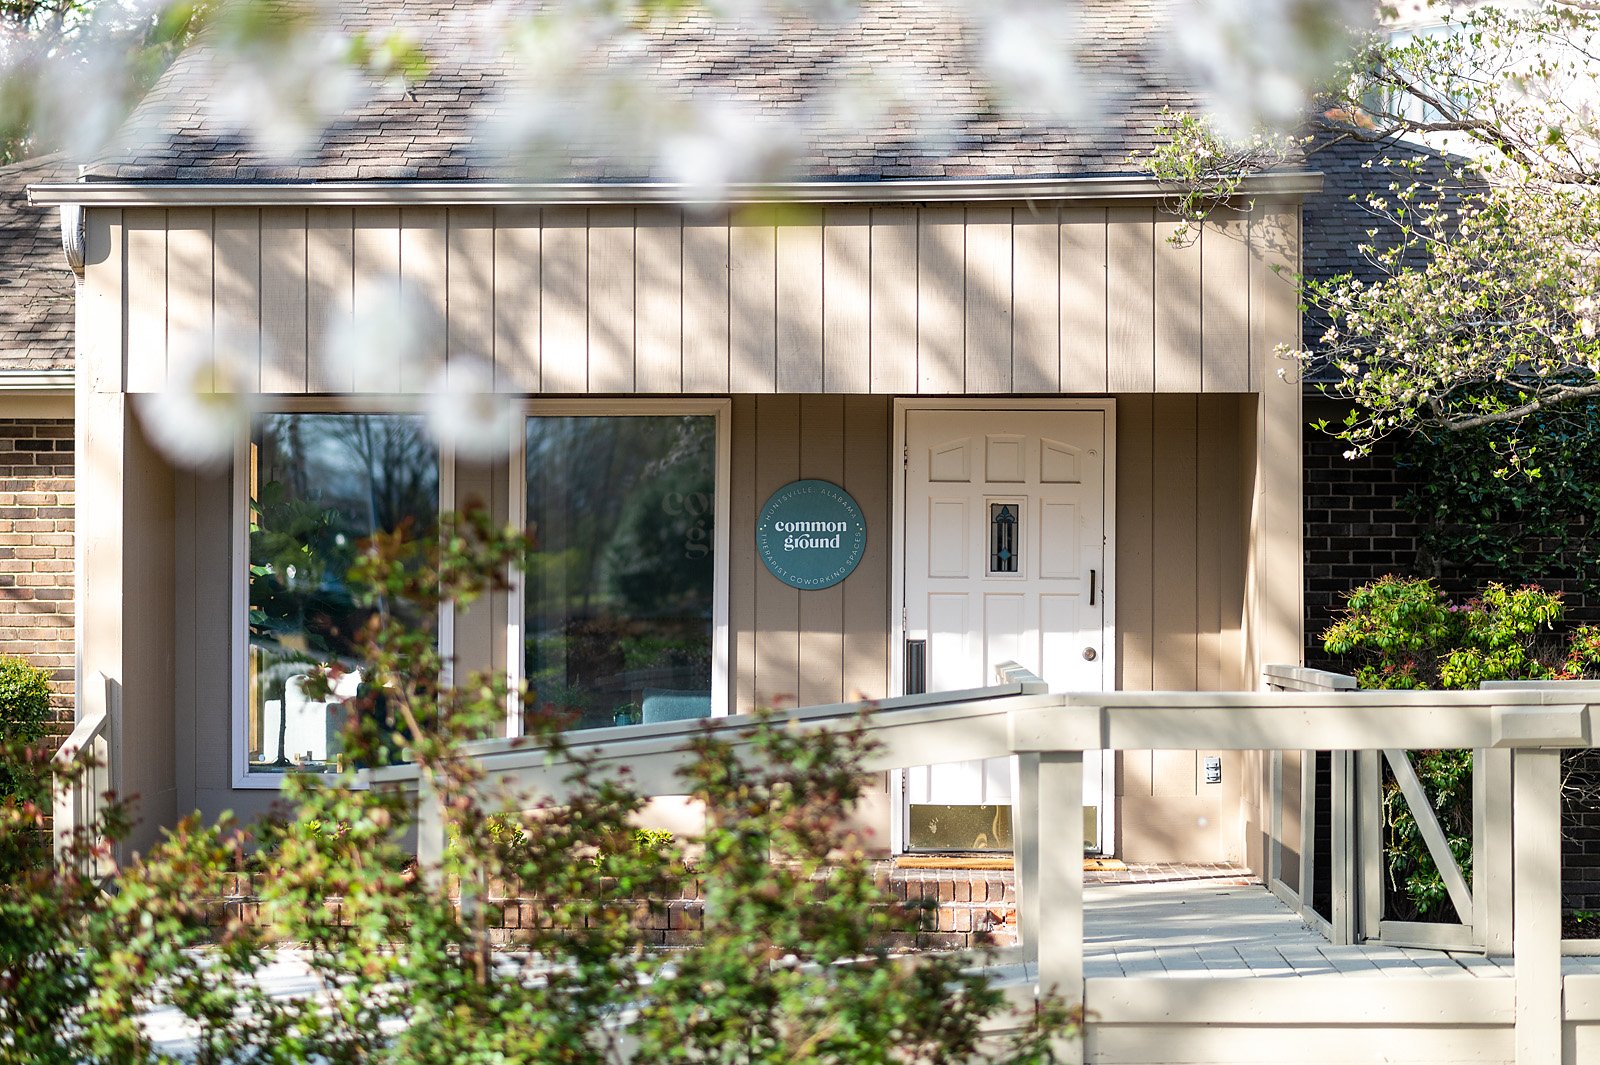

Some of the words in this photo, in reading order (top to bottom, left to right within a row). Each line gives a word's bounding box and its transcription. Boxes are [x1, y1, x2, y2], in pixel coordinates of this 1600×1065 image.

[662, 491, 715, 516] co
[820, 488, 857, 519] ALABAMA
[774, 521, 847, 533] common
[784, 533, 840, 552] ground
[761, 534, 787, 577] THERAPIST
[790, 566, 846, 585] COWORKING
[846, 531, 861, 566] SPACES
